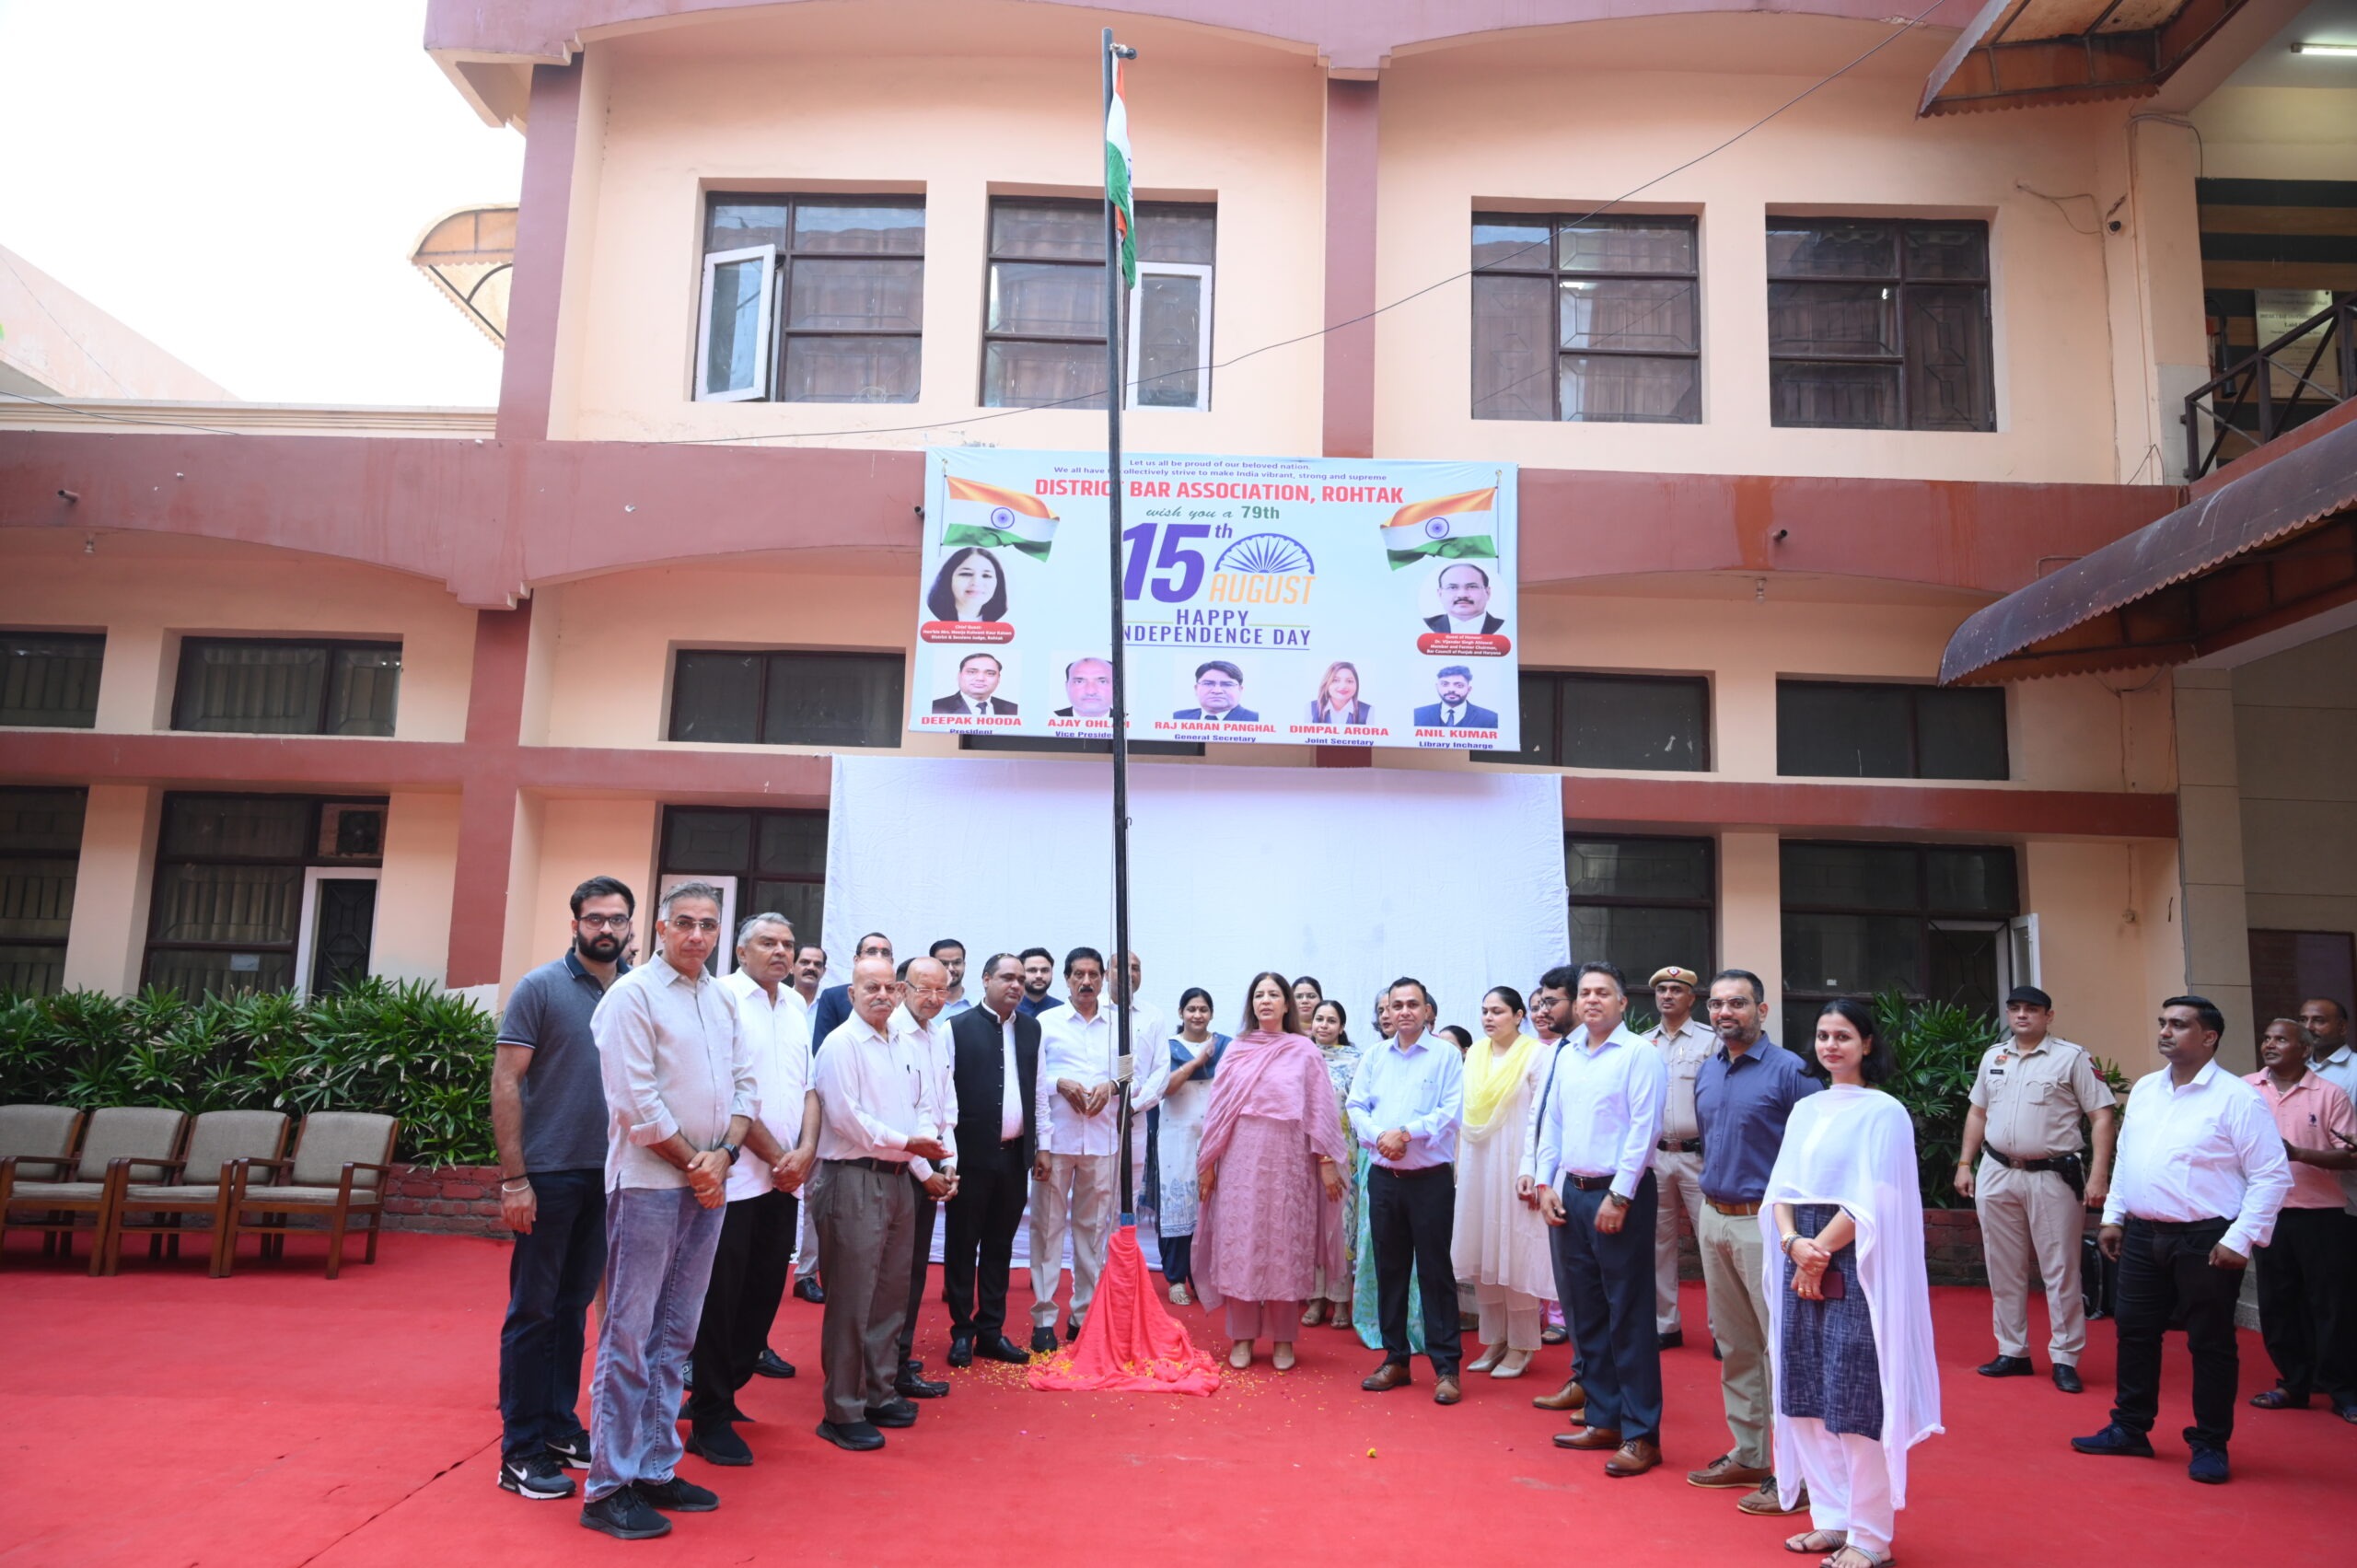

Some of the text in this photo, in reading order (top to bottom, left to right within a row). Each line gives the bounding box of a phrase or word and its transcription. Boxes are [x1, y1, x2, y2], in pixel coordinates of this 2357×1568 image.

[1123, 469, 1169, 477] ollectively
[1035, 479, 1404, 504] DISTRIC BAR ASSOCIATION, ROHTAK
[1146, 506, 1182, 517] wish
[1189, 509, 1216, 520] you
[1241, 505, 1280, 519] 79th
[1209, 573, 1317, 605] AUGUST
[1177, 609, 1249, 627] HAPPY
[1122, 625, 1311, 646] NDEPENDENCE DAY
[921, 716, 1022, 726] DEEPAK HOODA
[1048, 719, 1130, 728] AJAY OHL
[1155, 722, 1276, 733] RAJ KARAN PANGHAL
[1289, 726, 1389, 737] DIMPAL ARORA
[1213, 735, 1257, 743] Secretary
[1415, 729, 1498, 739] ANIL KUMAR
[1330, 738, 1375, 747] Secretary
[1419, 741, 1493, 749] Library Incharge
